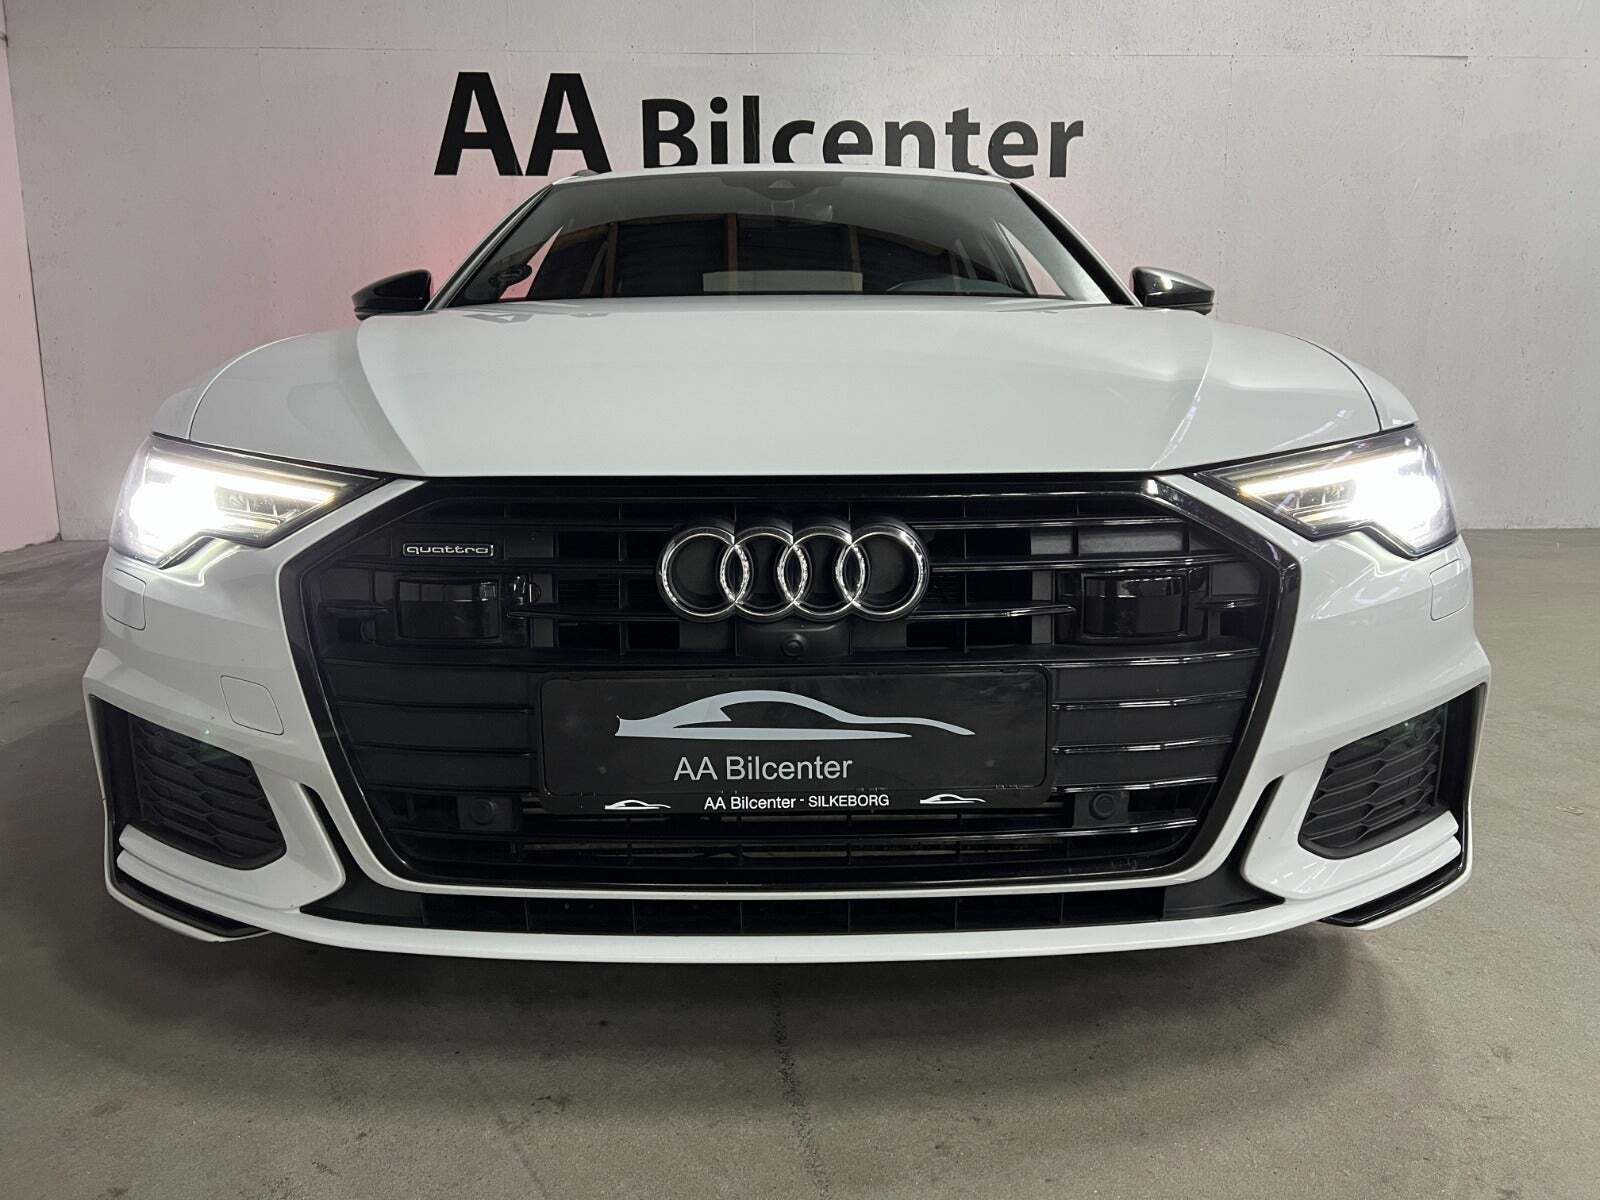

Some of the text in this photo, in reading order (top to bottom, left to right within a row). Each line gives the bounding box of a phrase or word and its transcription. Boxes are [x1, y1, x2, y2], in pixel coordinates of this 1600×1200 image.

[434, 71, 1084, 179] AA Bilcenter
[406, 545, 489, 555] quattro
[673, 755, 853, 781] AA Bilcenter
[703, 796, 727, 810] AA
[730, 795, 797, 810] Bilcenter
[808, 793, 890, 808] SILKEBORG
